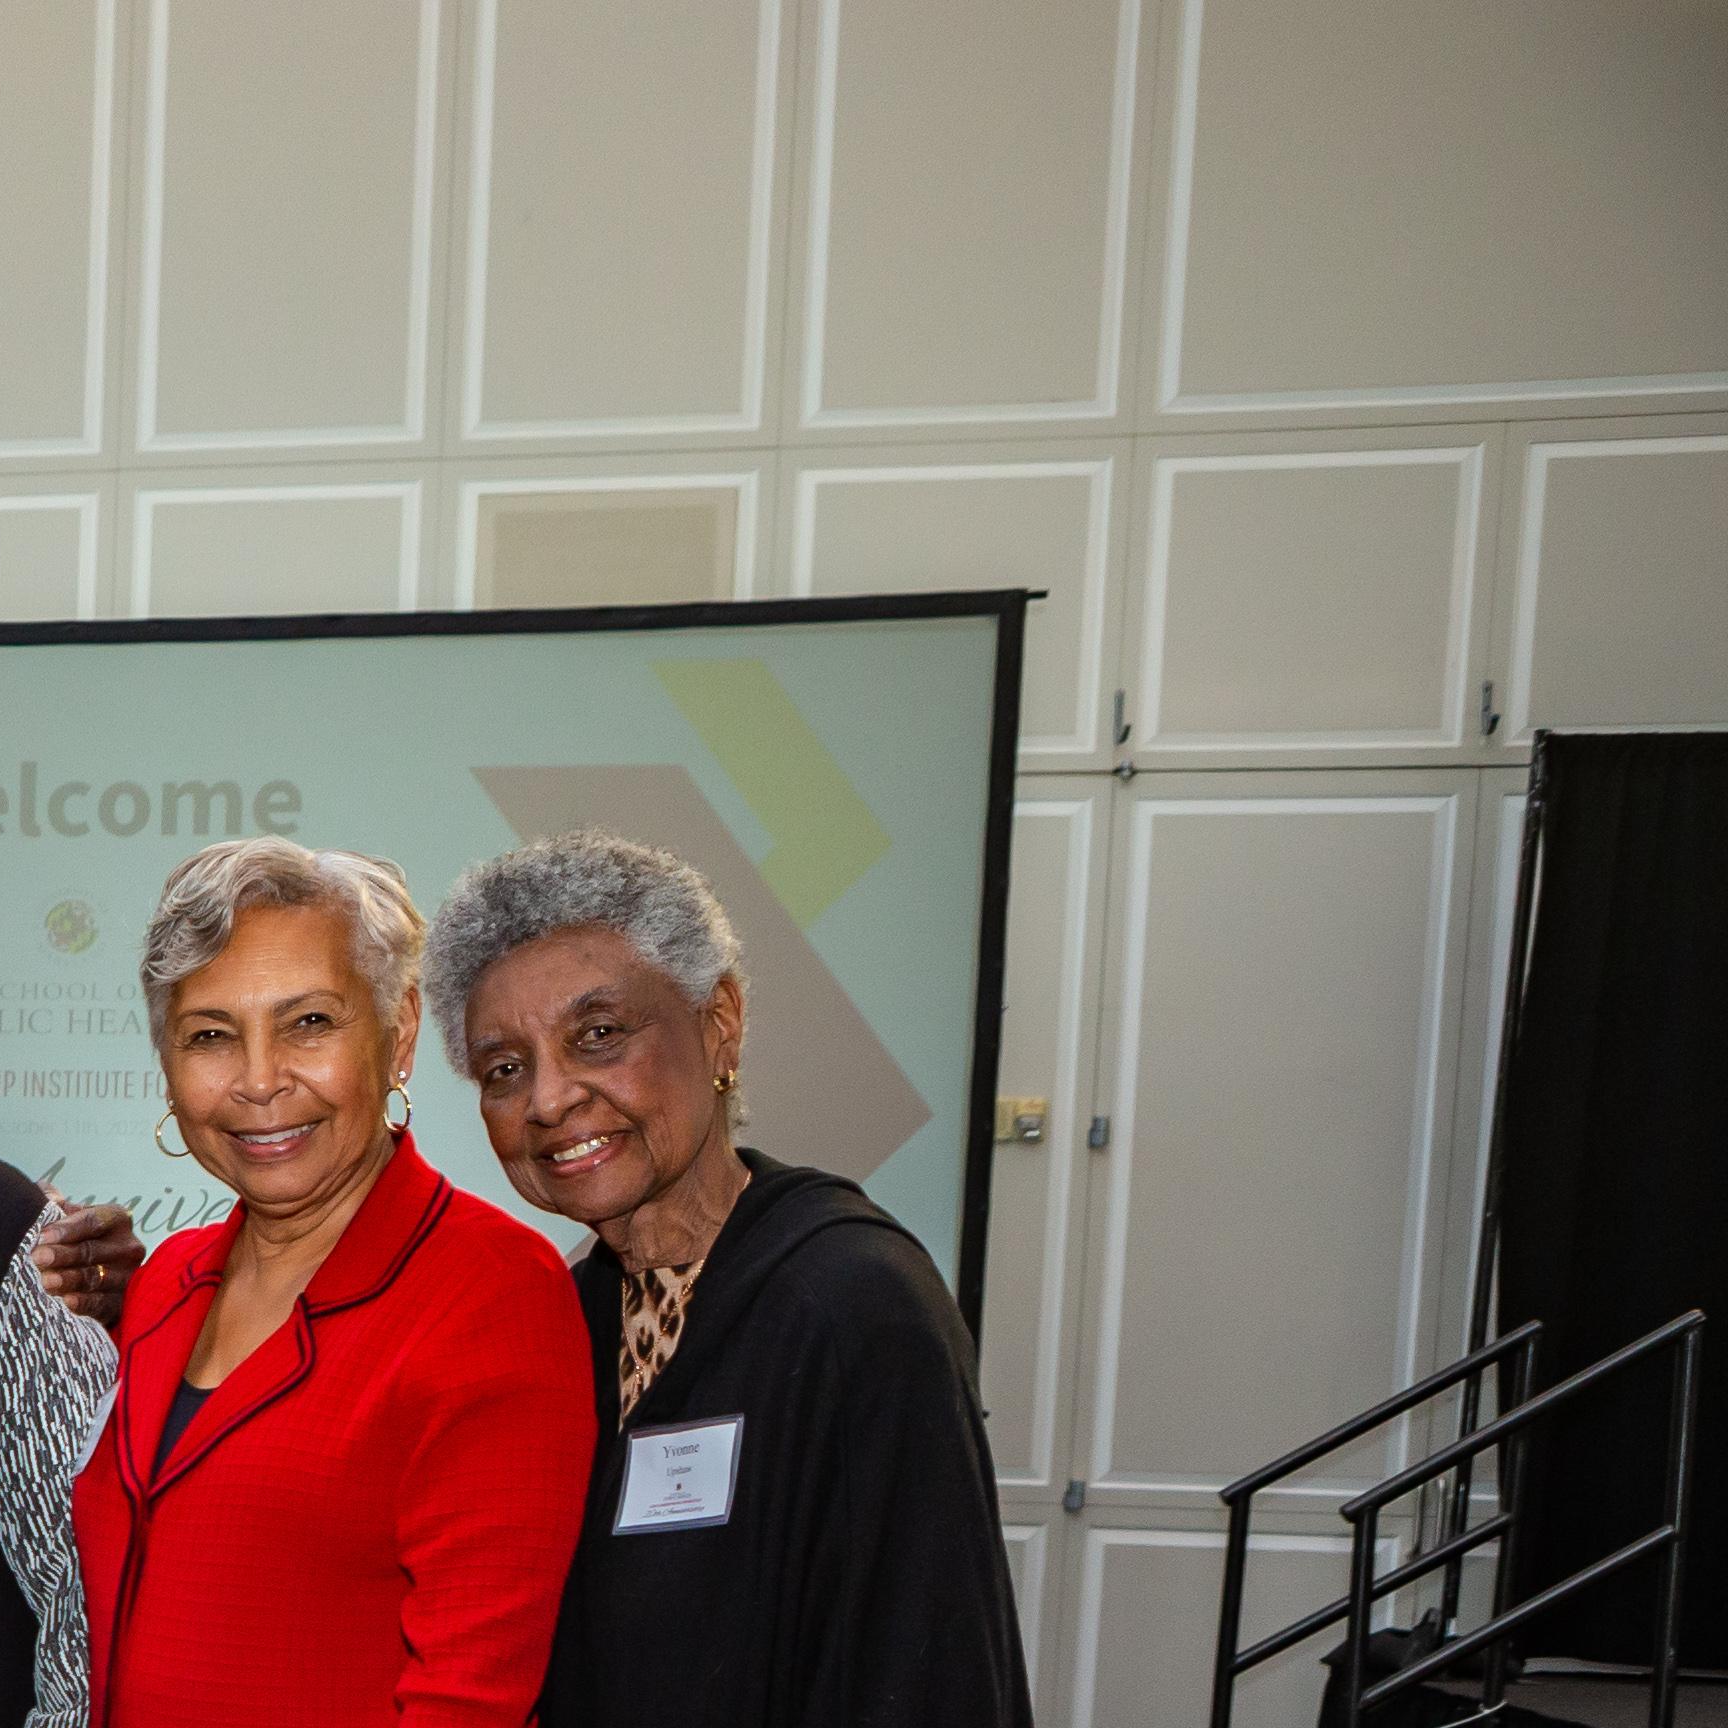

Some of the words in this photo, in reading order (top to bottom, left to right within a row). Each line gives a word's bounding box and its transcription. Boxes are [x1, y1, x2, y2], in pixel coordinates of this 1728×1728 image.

[116, 982, 138, 1001] O
[67, 1008, 143, 1035] HEA
[23, 1069, 135, 1099] INSTITUTE
[143, 1071, 170, 1100] FO
[663, 1444, 700, 1458] Yvonne
